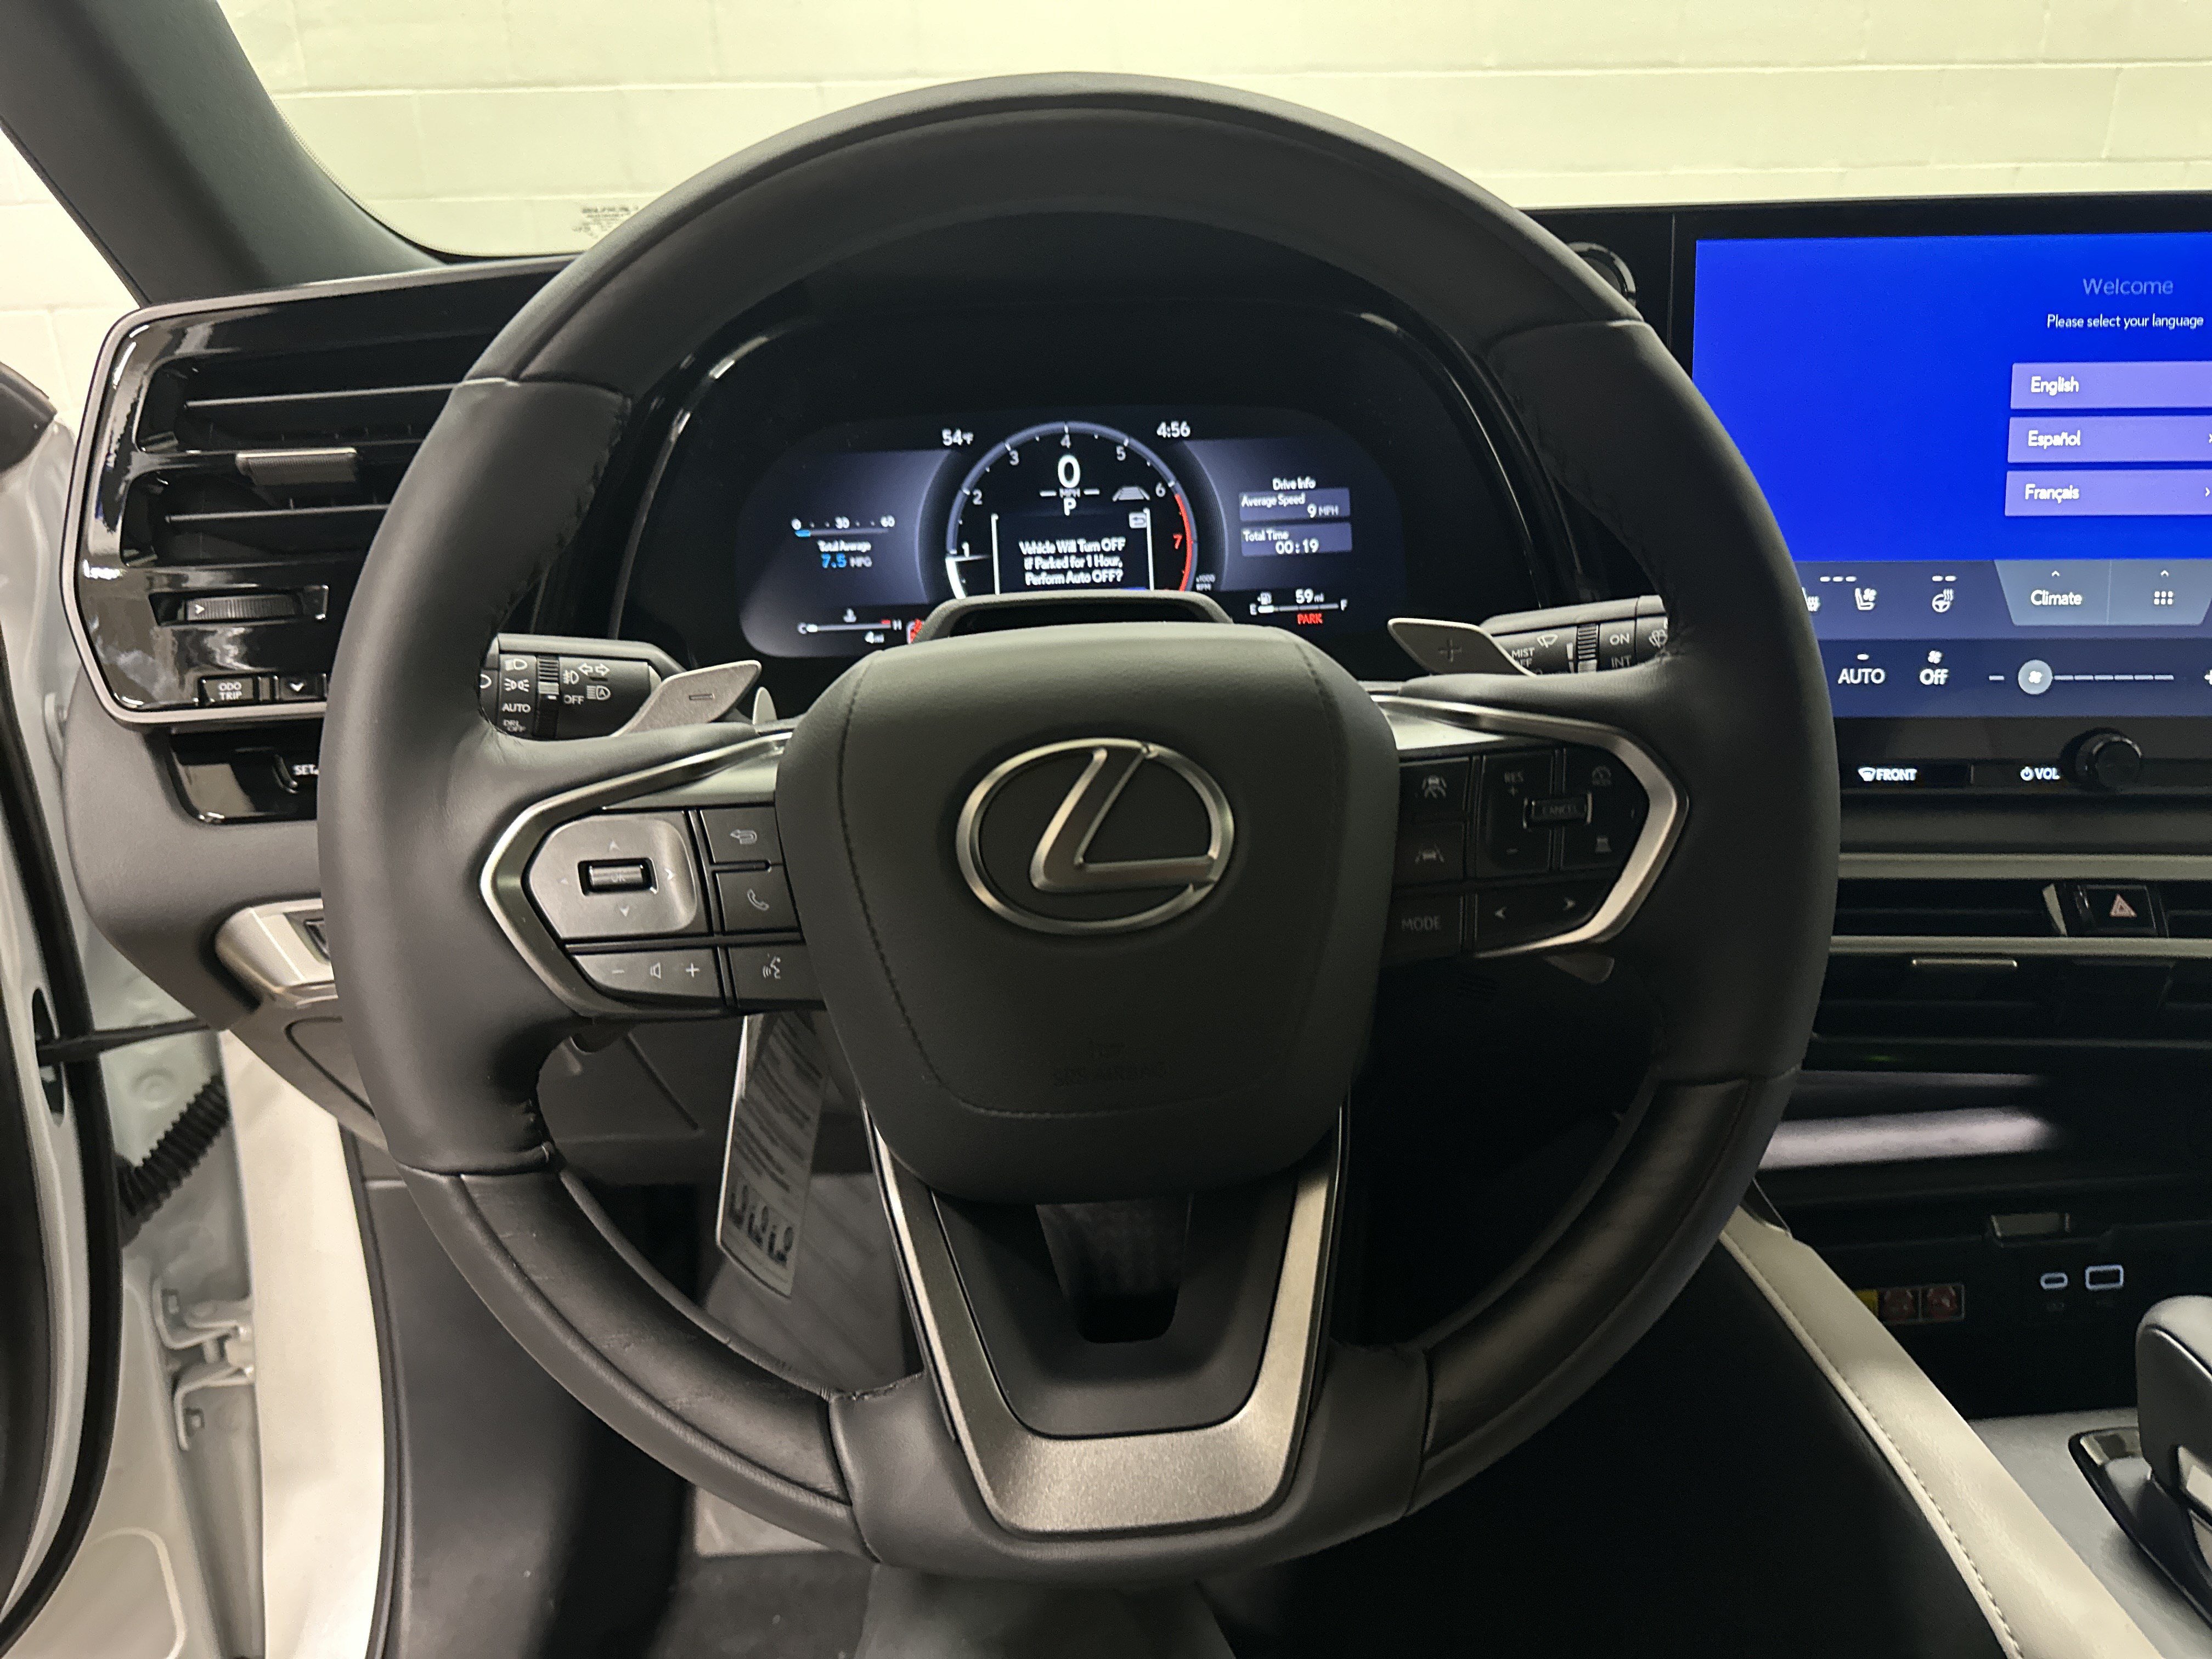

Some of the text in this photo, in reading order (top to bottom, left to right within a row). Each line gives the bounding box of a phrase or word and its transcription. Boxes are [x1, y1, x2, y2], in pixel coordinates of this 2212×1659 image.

[2083, 278, 2173, 296] Welcome
[2047, 313, 2204, 330] Please select your language
[2030, 376, 2079, 396] English
[1156, 421, 1190, 438] 4:56
[1060, 434, 1071, 448] 4
[2028, 430, 2081, 449] Español
[1008, 451, 1019, 465] 3
[1116, 447, 1126, 461] 5
[1058, 454, 1081, 488] 0
[1155, 483, 1166, 497] 6
[1272, 476, 1316, 490] Drive Info
[973, 490, 983, 505] 2
[1241, 493, 1306, 508] Average Speed
[2025, 484, 2079, 504] Français
[1063, 497, 1076, 516] P
[1307, 504, 1339, 518] 9 MPH
[791, 515, 895, 531] 0 30 60
[1173, 534, 1183, 549] 7
[1243, 528, 1289, 541] Total Time
[962, 543, 969, 557] 1
[1019, 537, 1126, 555] Vehicle Will Turn OFF
[1276, 538, 1319, 554] 00:19
[821, 553, 847, 568] 7.5
[1034, 555, 1069, 569] Parked
[1070, 555, 1085, 568] for
[1086, 554, 1092, 567] 1
[1025, 568, 1123, 585] Perform Auto OFF?
[1295, 588, 1314, 603] 59
[2030, 589, 2083, 606] Climate
[1249, 603, 1257, 616] E
[1340, 599, 1348, 611] F
[1297, 613, 1323, 625] PARK
[1609, 634, 1630, 645] ON
[1511, 647, 1534, 658] MIST
[1611, 655, 1632, 669] INT
[1838, 669, 1886, 685] AUTO
[1919, 669, 1949, 685] Off
[218, 682, 241, 691] ODO
[219, 691, 242, 701] TRIP
[563, 695, 584, 706] OFF
[502, 703, 531, 713] AUTO
[1876, 768, 1917, 781] FRONT
[2034, 768, 2060, 780] VOL
[1401, 916, 1441, 932] MODE
